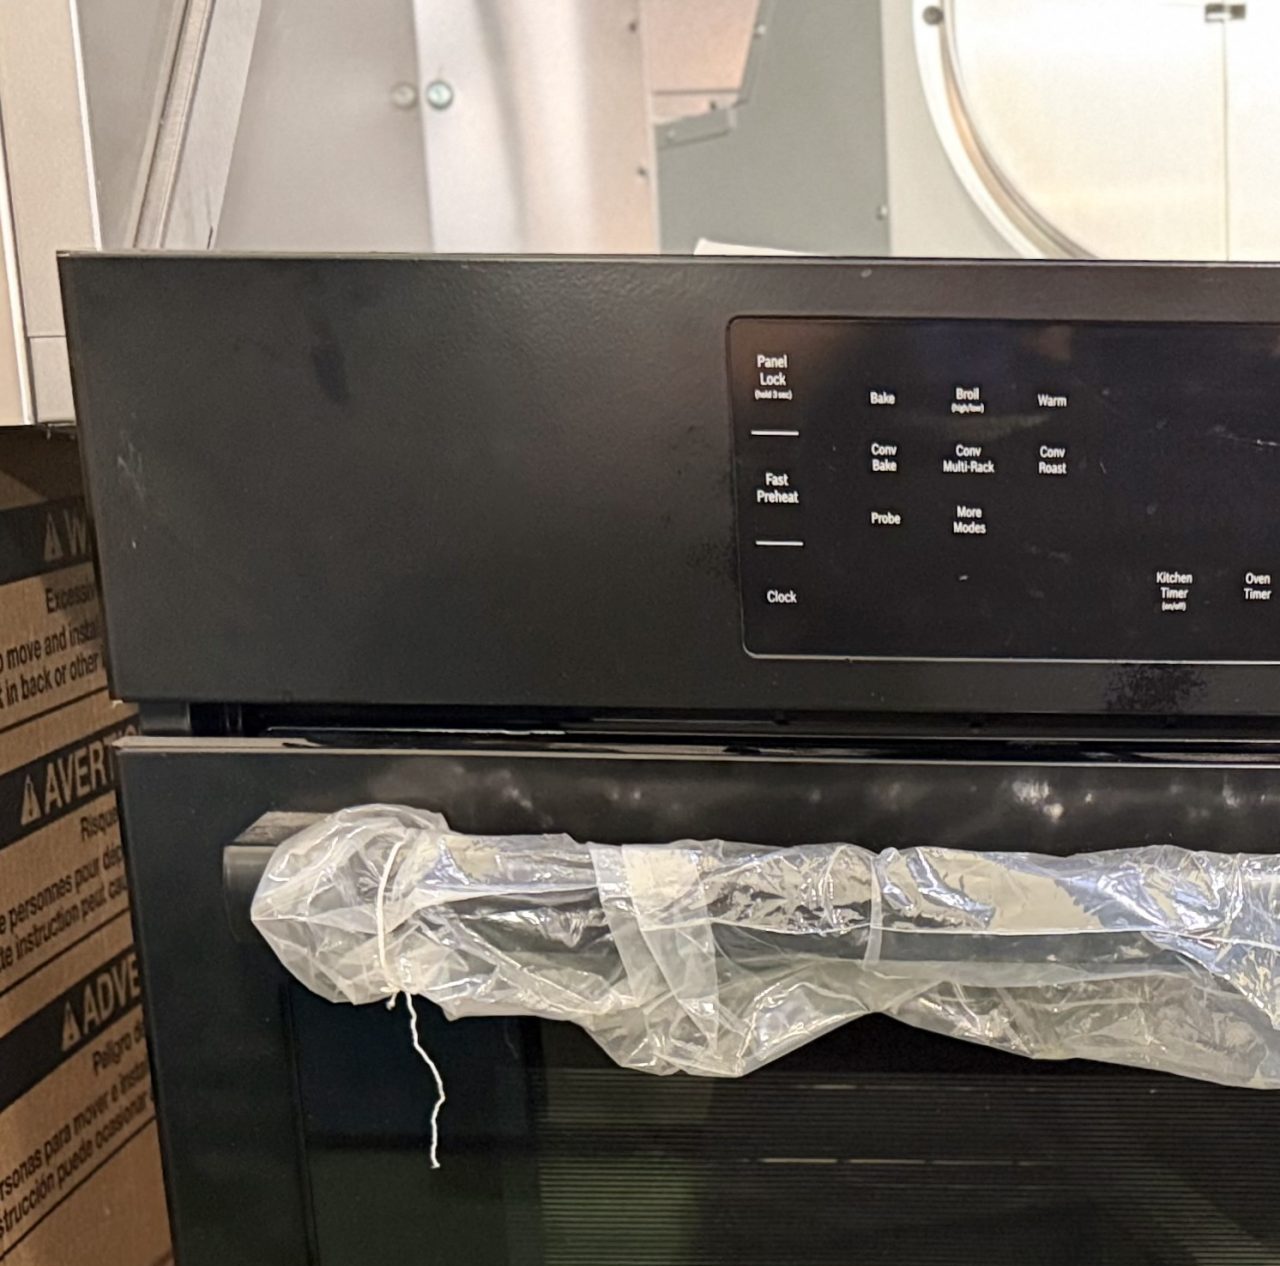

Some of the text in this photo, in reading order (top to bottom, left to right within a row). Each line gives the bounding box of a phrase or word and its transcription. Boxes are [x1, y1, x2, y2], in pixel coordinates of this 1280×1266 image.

[756, 353, 788, 369] Panel
[759, 371, 787, 386] Lock
[869, 391, 896, 405] Bake
[955, 386, 980, 401] Broil
[1037, 393, 1068, 407] Warm
[870, 442, 898, 456] Conv
[955, 443, 982, 458] Conv
[1039, 444, 1066, 459] Conv
[871, 458, 898, 472] Bake
[942, 459, 996, 474] Multi-Rack
[1038, 460, 1067, 475] Roast
[765, 471, 790, 487] Fast
[756, 488, 800, 504] Preheat
[870, 511, 902, 525] Probe
[956, 504, 983, 519] More
[952, 520, 987, 535] Modes
[1156, 570, 1194, 584] Kitchen
[1245, 571, 1271, 585] Oven
[766, 589, 798, 604] Clock
[1160, 586, 1189, 600] Timer
[1243, 587, 1272, 600] Timer
[6, 639, 41, 670] move
[44, 624, 67, 656] and
[5, 678, 19, 706] in
[20, 664, 52, 700] back
[54, 661, 67, 688] or
[69, 650, 99, 681] other
[8, 874, 72, 935] personnes
[74, 857, 100, 895] pour
[43, 1124, 73, 1167] para
